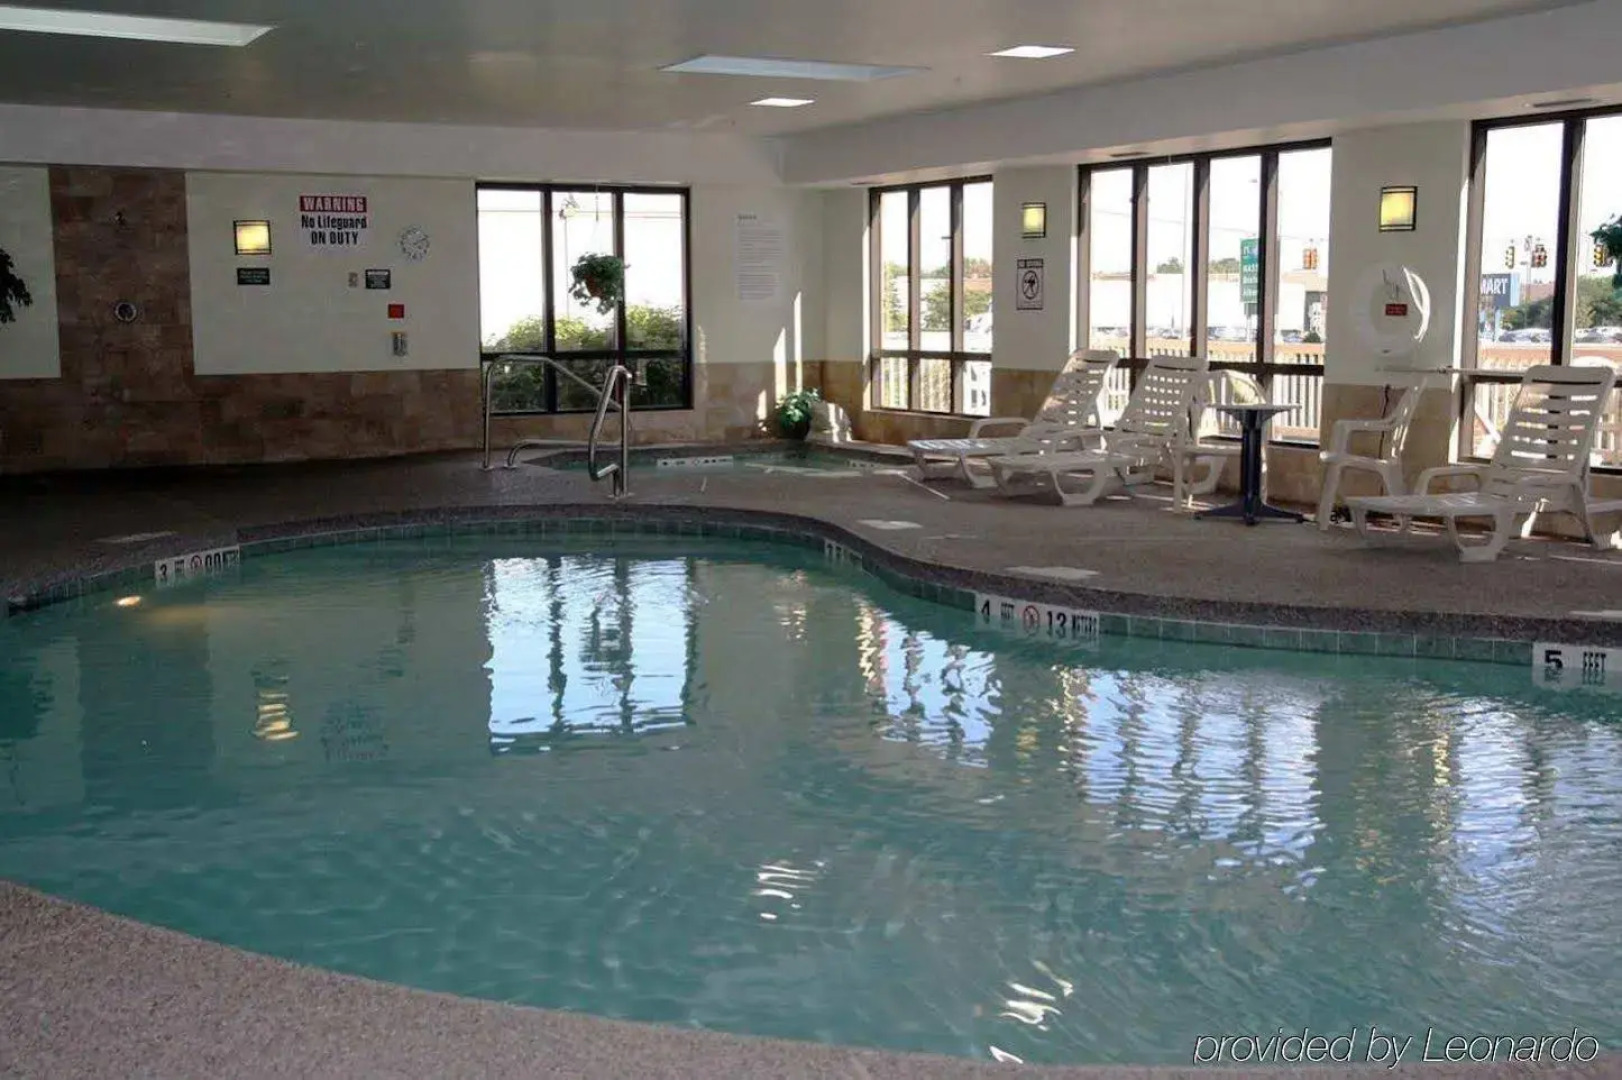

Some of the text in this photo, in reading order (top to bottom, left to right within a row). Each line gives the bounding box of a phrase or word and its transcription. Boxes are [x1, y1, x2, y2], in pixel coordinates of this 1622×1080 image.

[303, 197, 364, 212] WARNING
[301, 215, 367, 230] No Lifeguard
[311, 231, 359, 245] ON DUTY
[1544, 650, 1563, 669] 5
